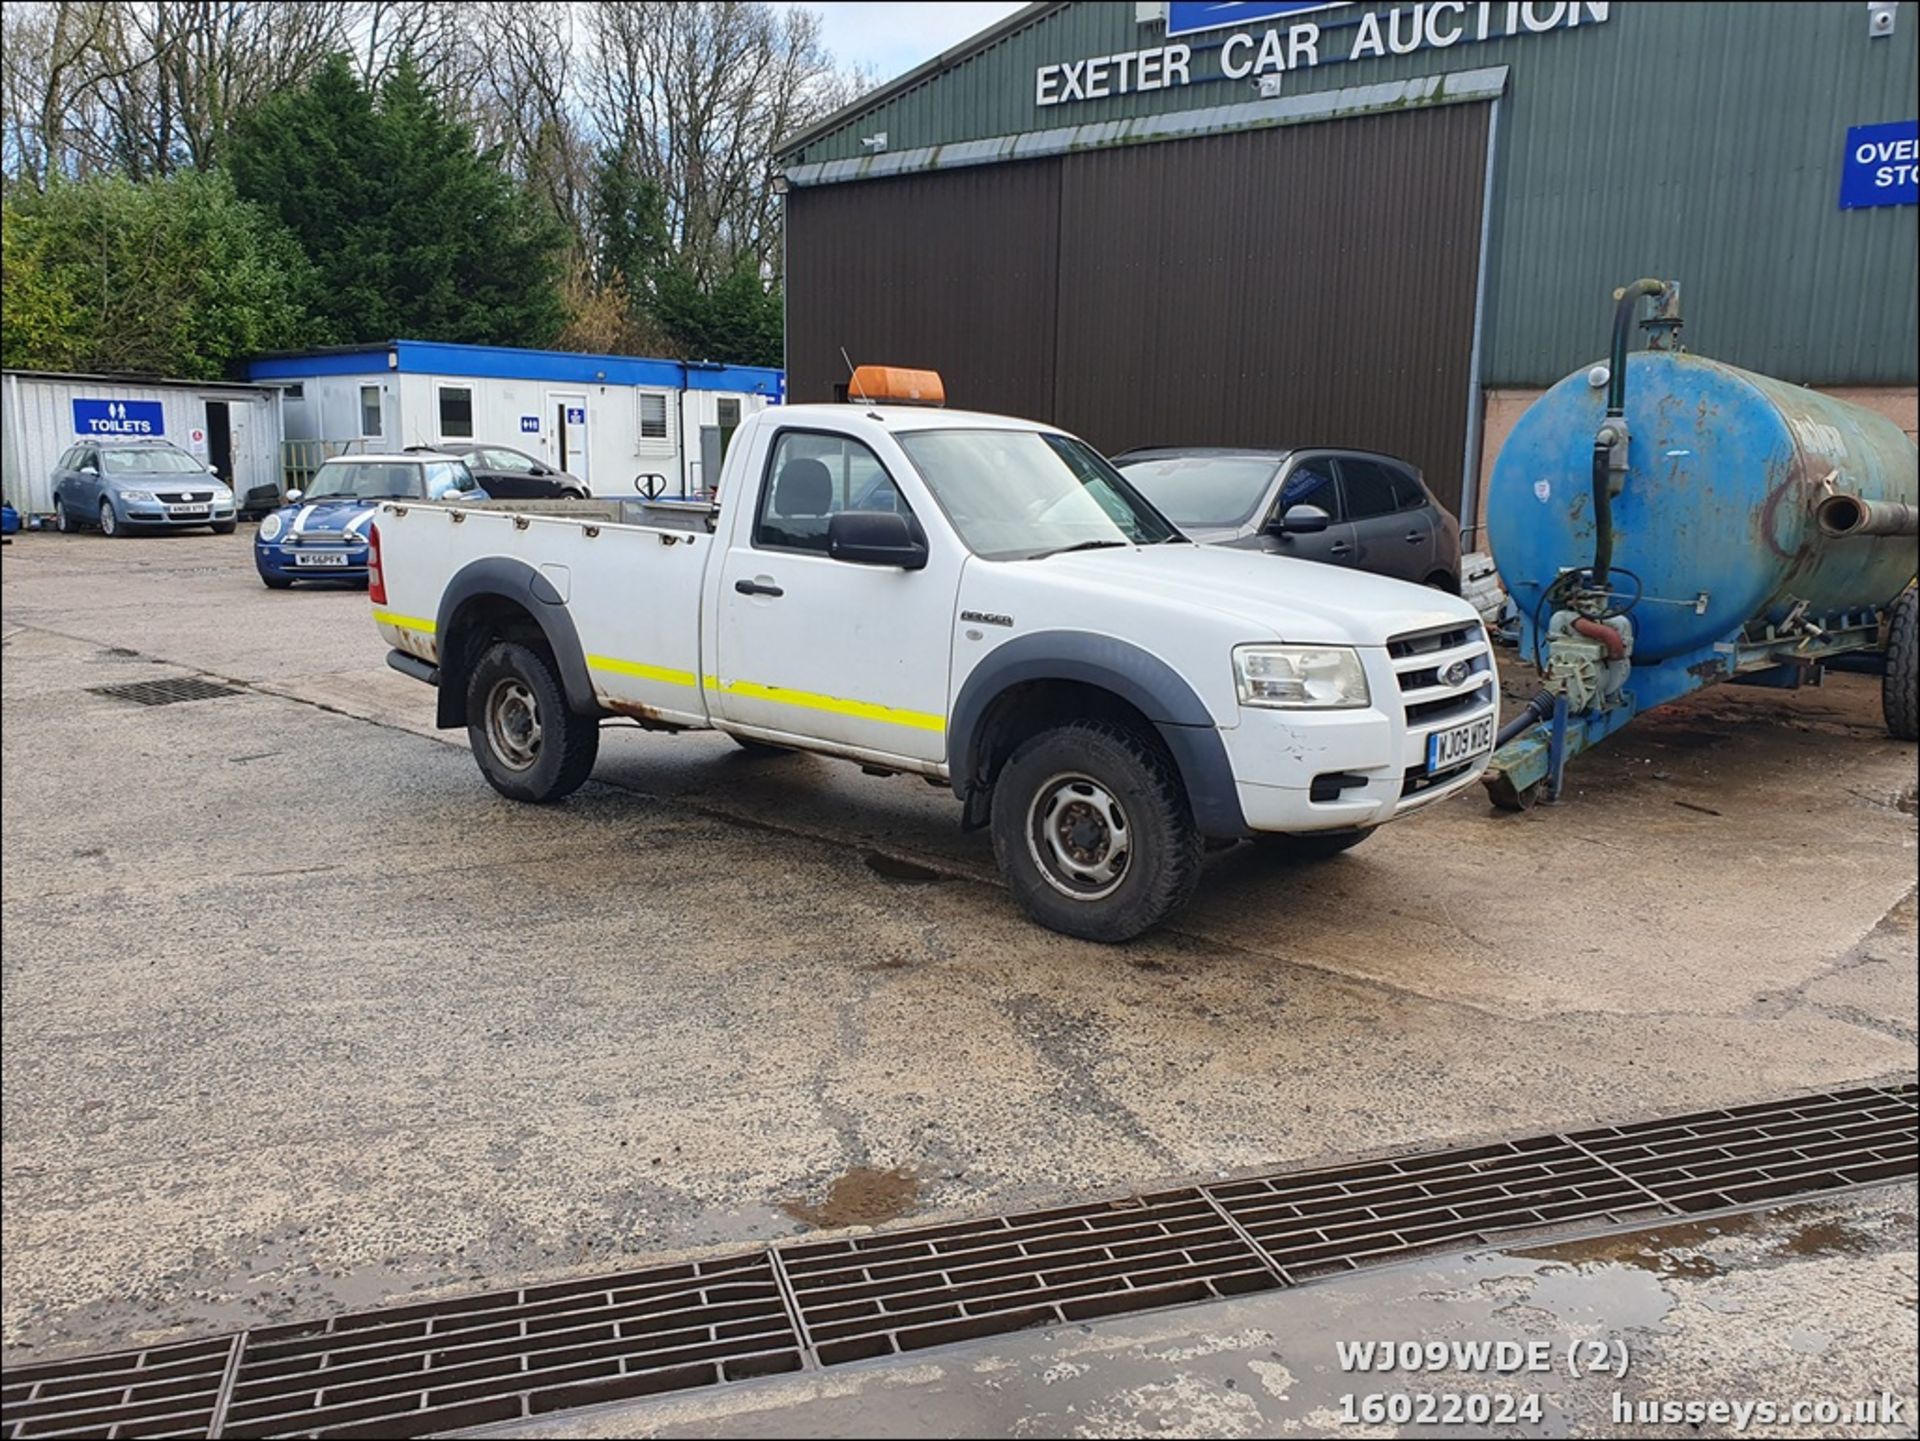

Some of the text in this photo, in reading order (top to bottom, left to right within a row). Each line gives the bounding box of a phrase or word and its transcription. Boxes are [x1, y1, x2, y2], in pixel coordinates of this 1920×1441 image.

[1036, 2, 1610, 106] EXETER CAR AUCTION
[1856, 139, 1919, 164] OVE
[89, 419, 151, 433] TOILETS
[1439, 720, 1490, 762] WJ09 WDE
